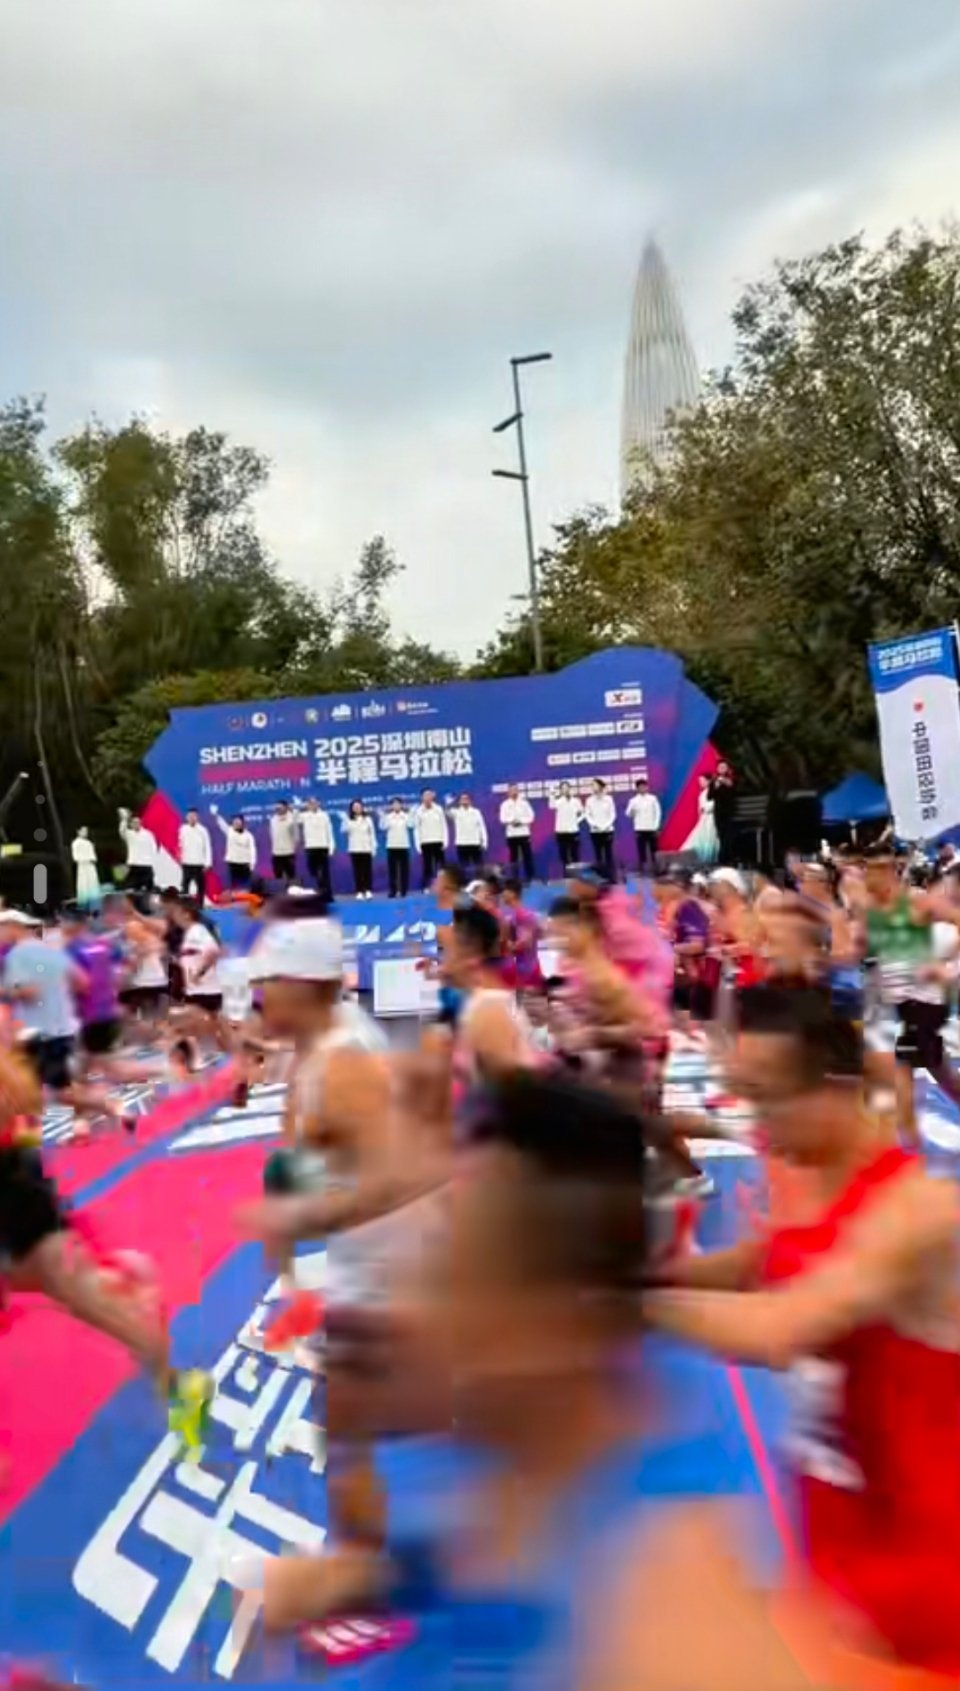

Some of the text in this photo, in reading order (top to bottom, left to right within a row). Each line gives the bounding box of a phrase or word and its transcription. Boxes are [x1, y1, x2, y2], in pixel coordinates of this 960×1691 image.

[200, 739, 308, 764] SHENZHEN
[314, 726, 471, 758] 2025深圳南山
[315, 747, 473, 786] 半程马拉松
[912, 721, 938, 821] 中国田径协会
[201, 777, 311, 795] HALF MARATHN
